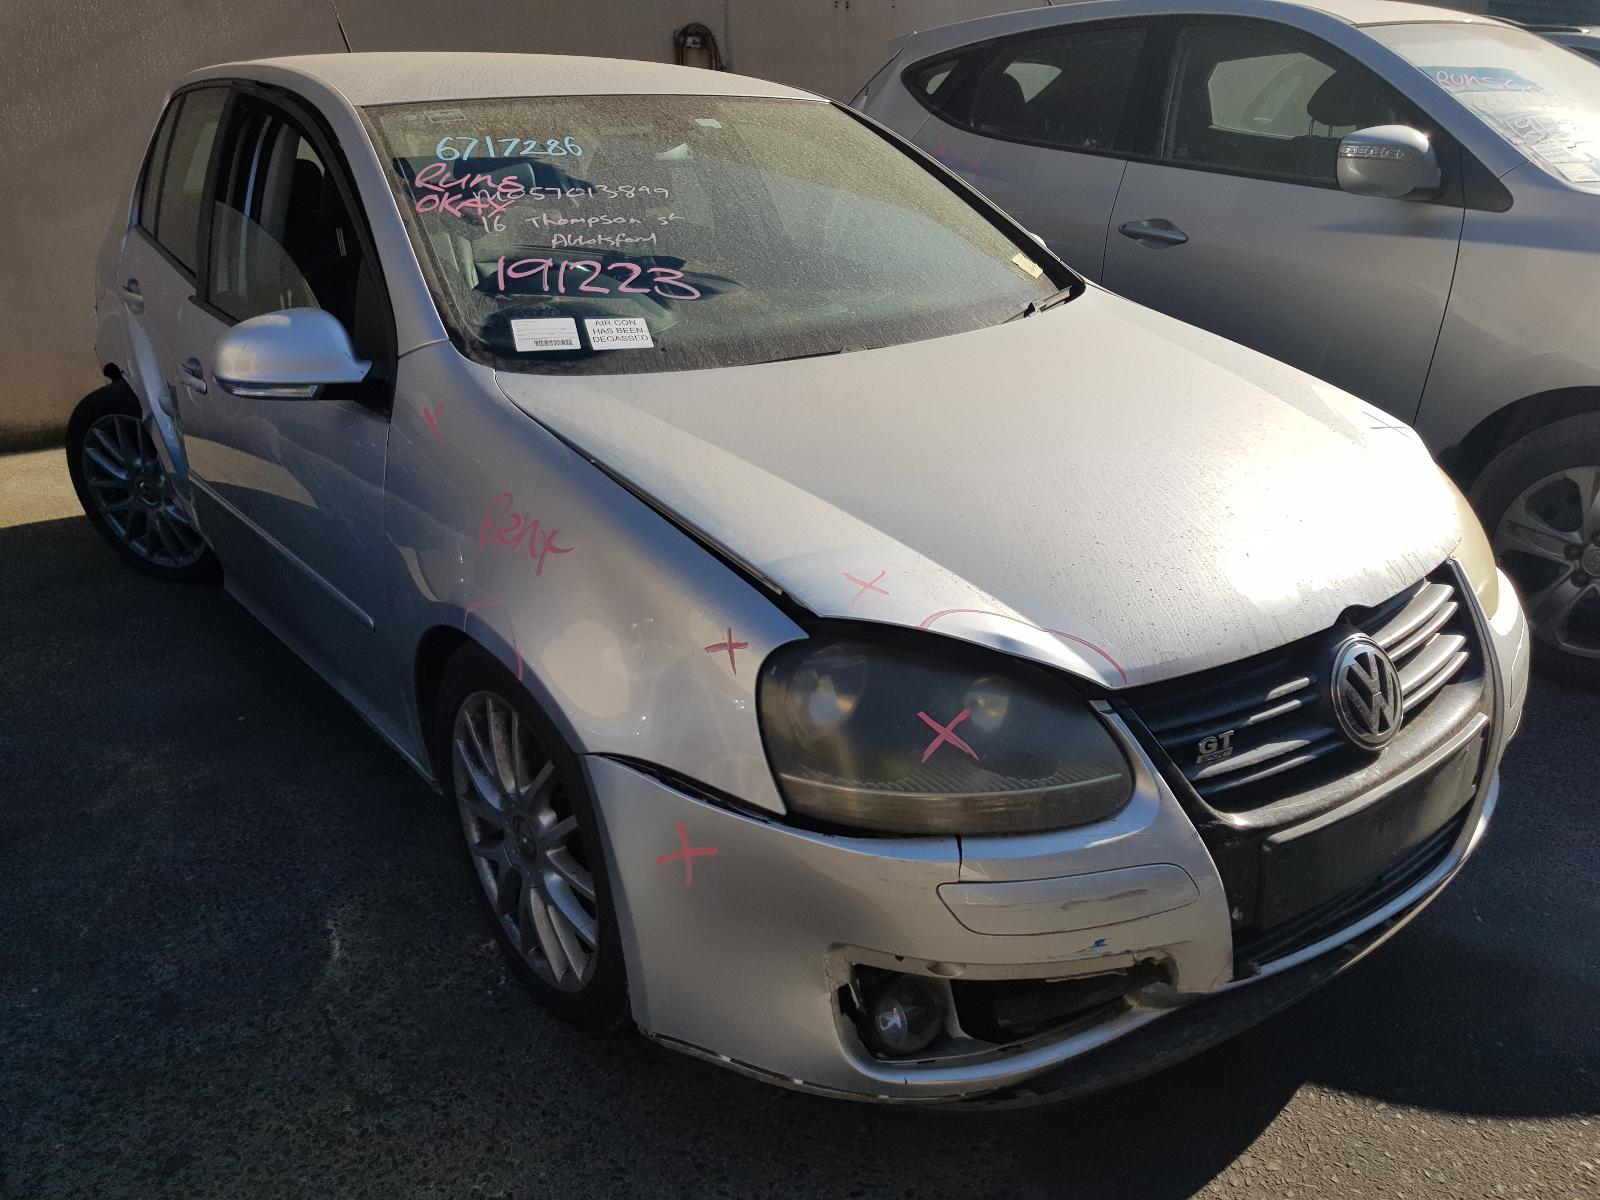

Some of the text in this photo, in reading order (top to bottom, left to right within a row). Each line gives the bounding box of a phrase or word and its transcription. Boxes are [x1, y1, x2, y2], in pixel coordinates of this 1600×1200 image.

[436, 136, 583, 161] 6717286
[482, 215, 507, 234] 16
[525, 213, 642, 228] Thompson
[496, 255, 701, 300] 191223
[592, 327, 614, 335] HAS
[592, 335, 649, 343] DEGASSED
[1198, 730, 1235, 755] GT
